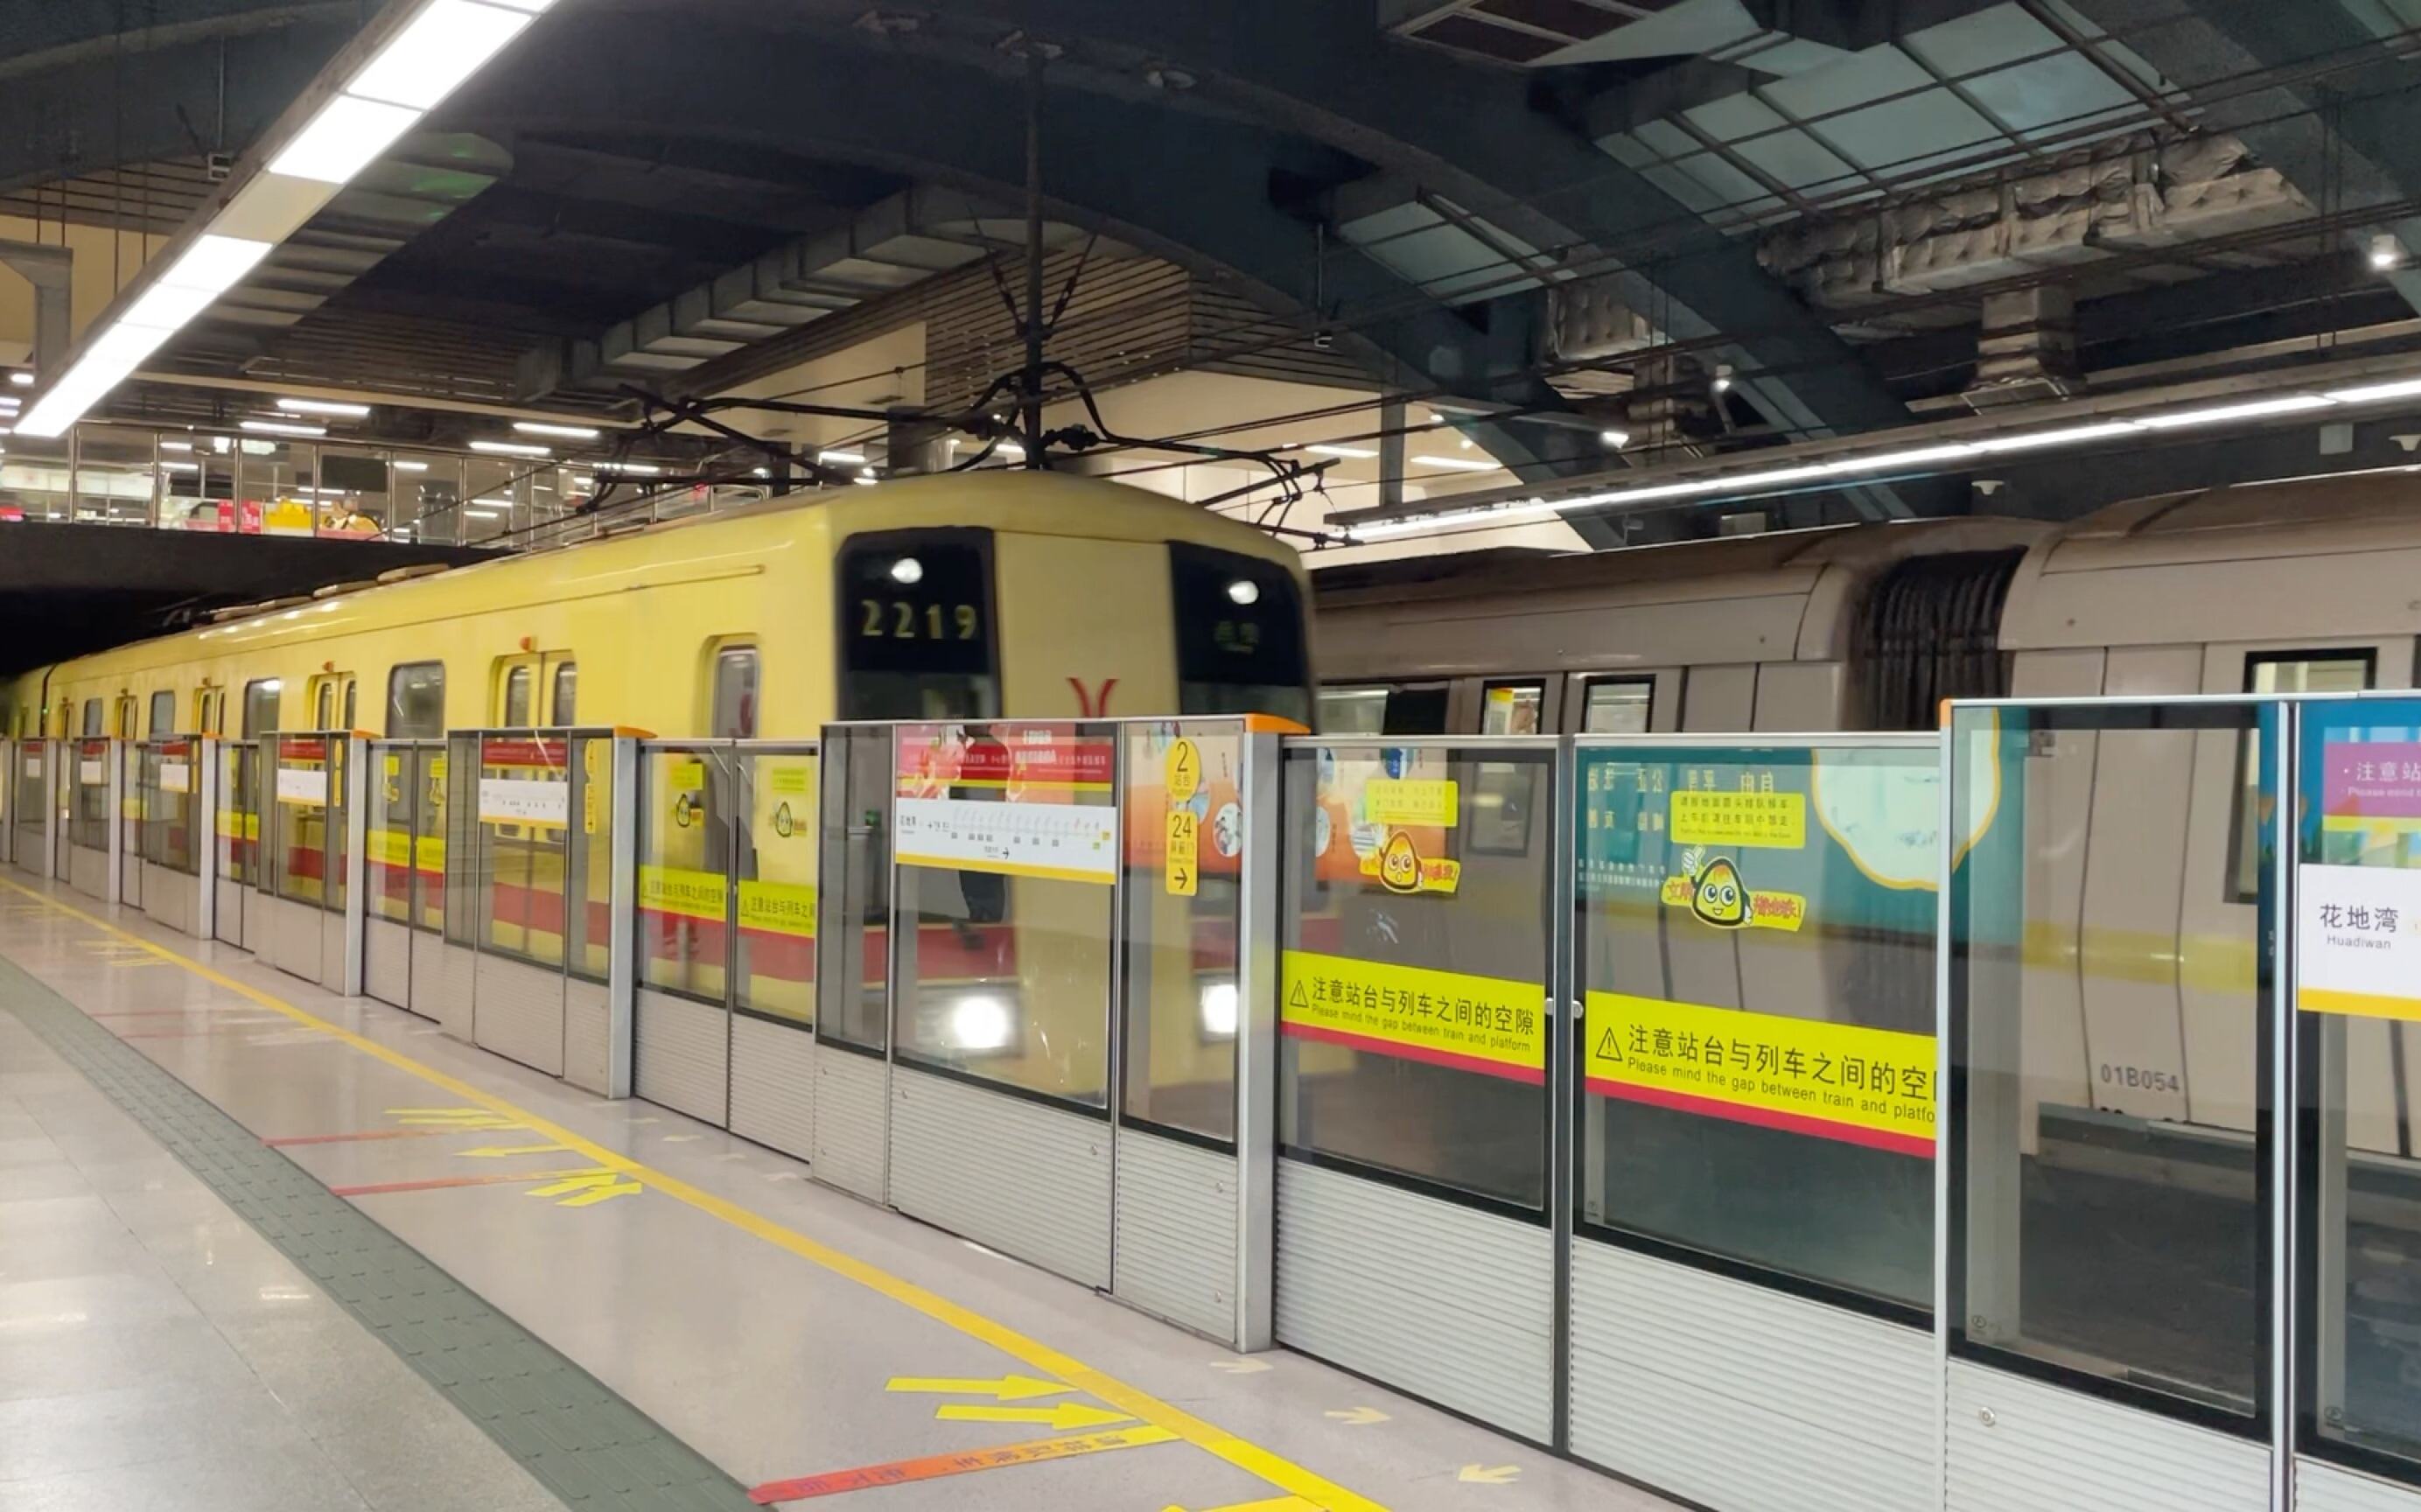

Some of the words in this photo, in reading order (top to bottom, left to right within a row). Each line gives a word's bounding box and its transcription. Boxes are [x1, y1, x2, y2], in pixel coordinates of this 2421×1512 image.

[861, 600, 977, 640] 2219
[1177, 742, 1188, 772] 2
[1172, 815, 1191, 837] 24
[2320, 903, 2398, 933] 花地湾
[2327, 934, 2391, 950] Huadiwan
[1312, 976, 1534, 1036] 注意站台与列车之间的空隙
[1312, 1004, 1339, 1018] Please
[1342, 1012, 1362, 1024] mind
[1365, 1013, 1379, 1026] the
[1382, 1018, 1398, 1031] gap
[1402, 1020, 1440, 1037] between
[1443, 1026, 1465, 1041] train
[1468, 1032, 1487, 1045] and
[1490, 1035, 1531, 1052] platform
[1628, 1024, 1936, 1101] 注意站台与列车之间的空
[2101, 1064, 2180, 1091] 01B054
[1627, 1057, 1667, 1075] Please
[1673, 1065, 1702, 1082] mind
[1706, 1070, 1726, 1086] the
[1731, 1077, 1756, 1092] gap
[1761, 1080, 1817, 1102] between
[1823, 1090, 1854, 1108] train
[1860, 1096, 1887, 1114] and
